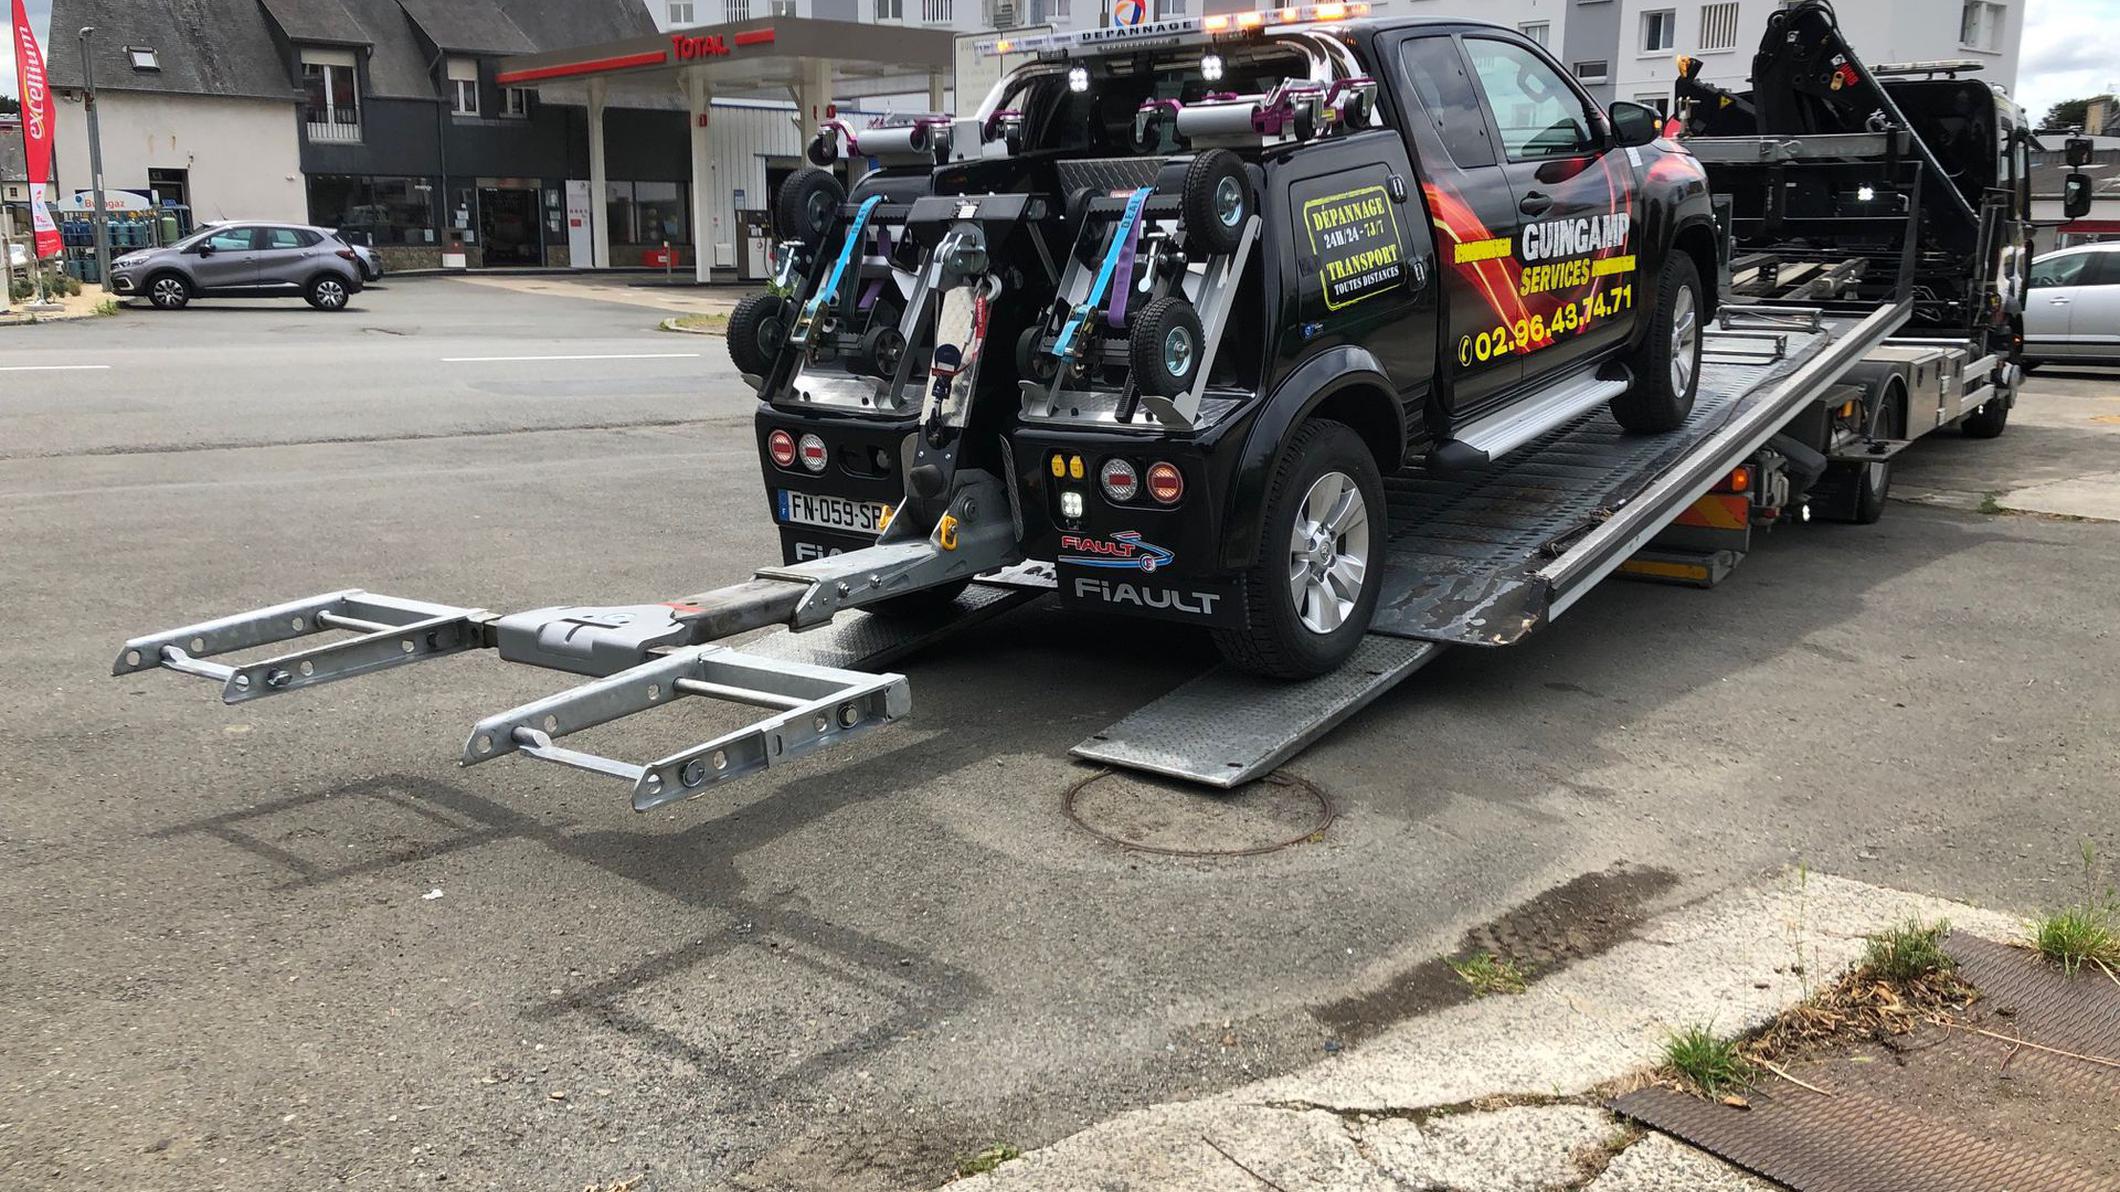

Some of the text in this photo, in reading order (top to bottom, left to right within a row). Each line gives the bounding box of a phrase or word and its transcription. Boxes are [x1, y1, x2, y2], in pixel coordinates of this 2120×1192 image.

[672, 35, 730, 60] TOTAL
[1082, 21, 1193, 41] DEPANNAGE
[19, 25, 44, 140] excellium
[1312, 197, 1386, 231] DÉPANNAGE
[1522, 212, 1631, 261] GUINGAMP
[1326, 244, 1398, 281] TRANSPORT
[1333, 265, 1400, 296] TOUTES DISTANCES
[1519, 258, 1590, 297] SERVICES
[1475, 284, 1632, 361] 02.96.43.74.71
